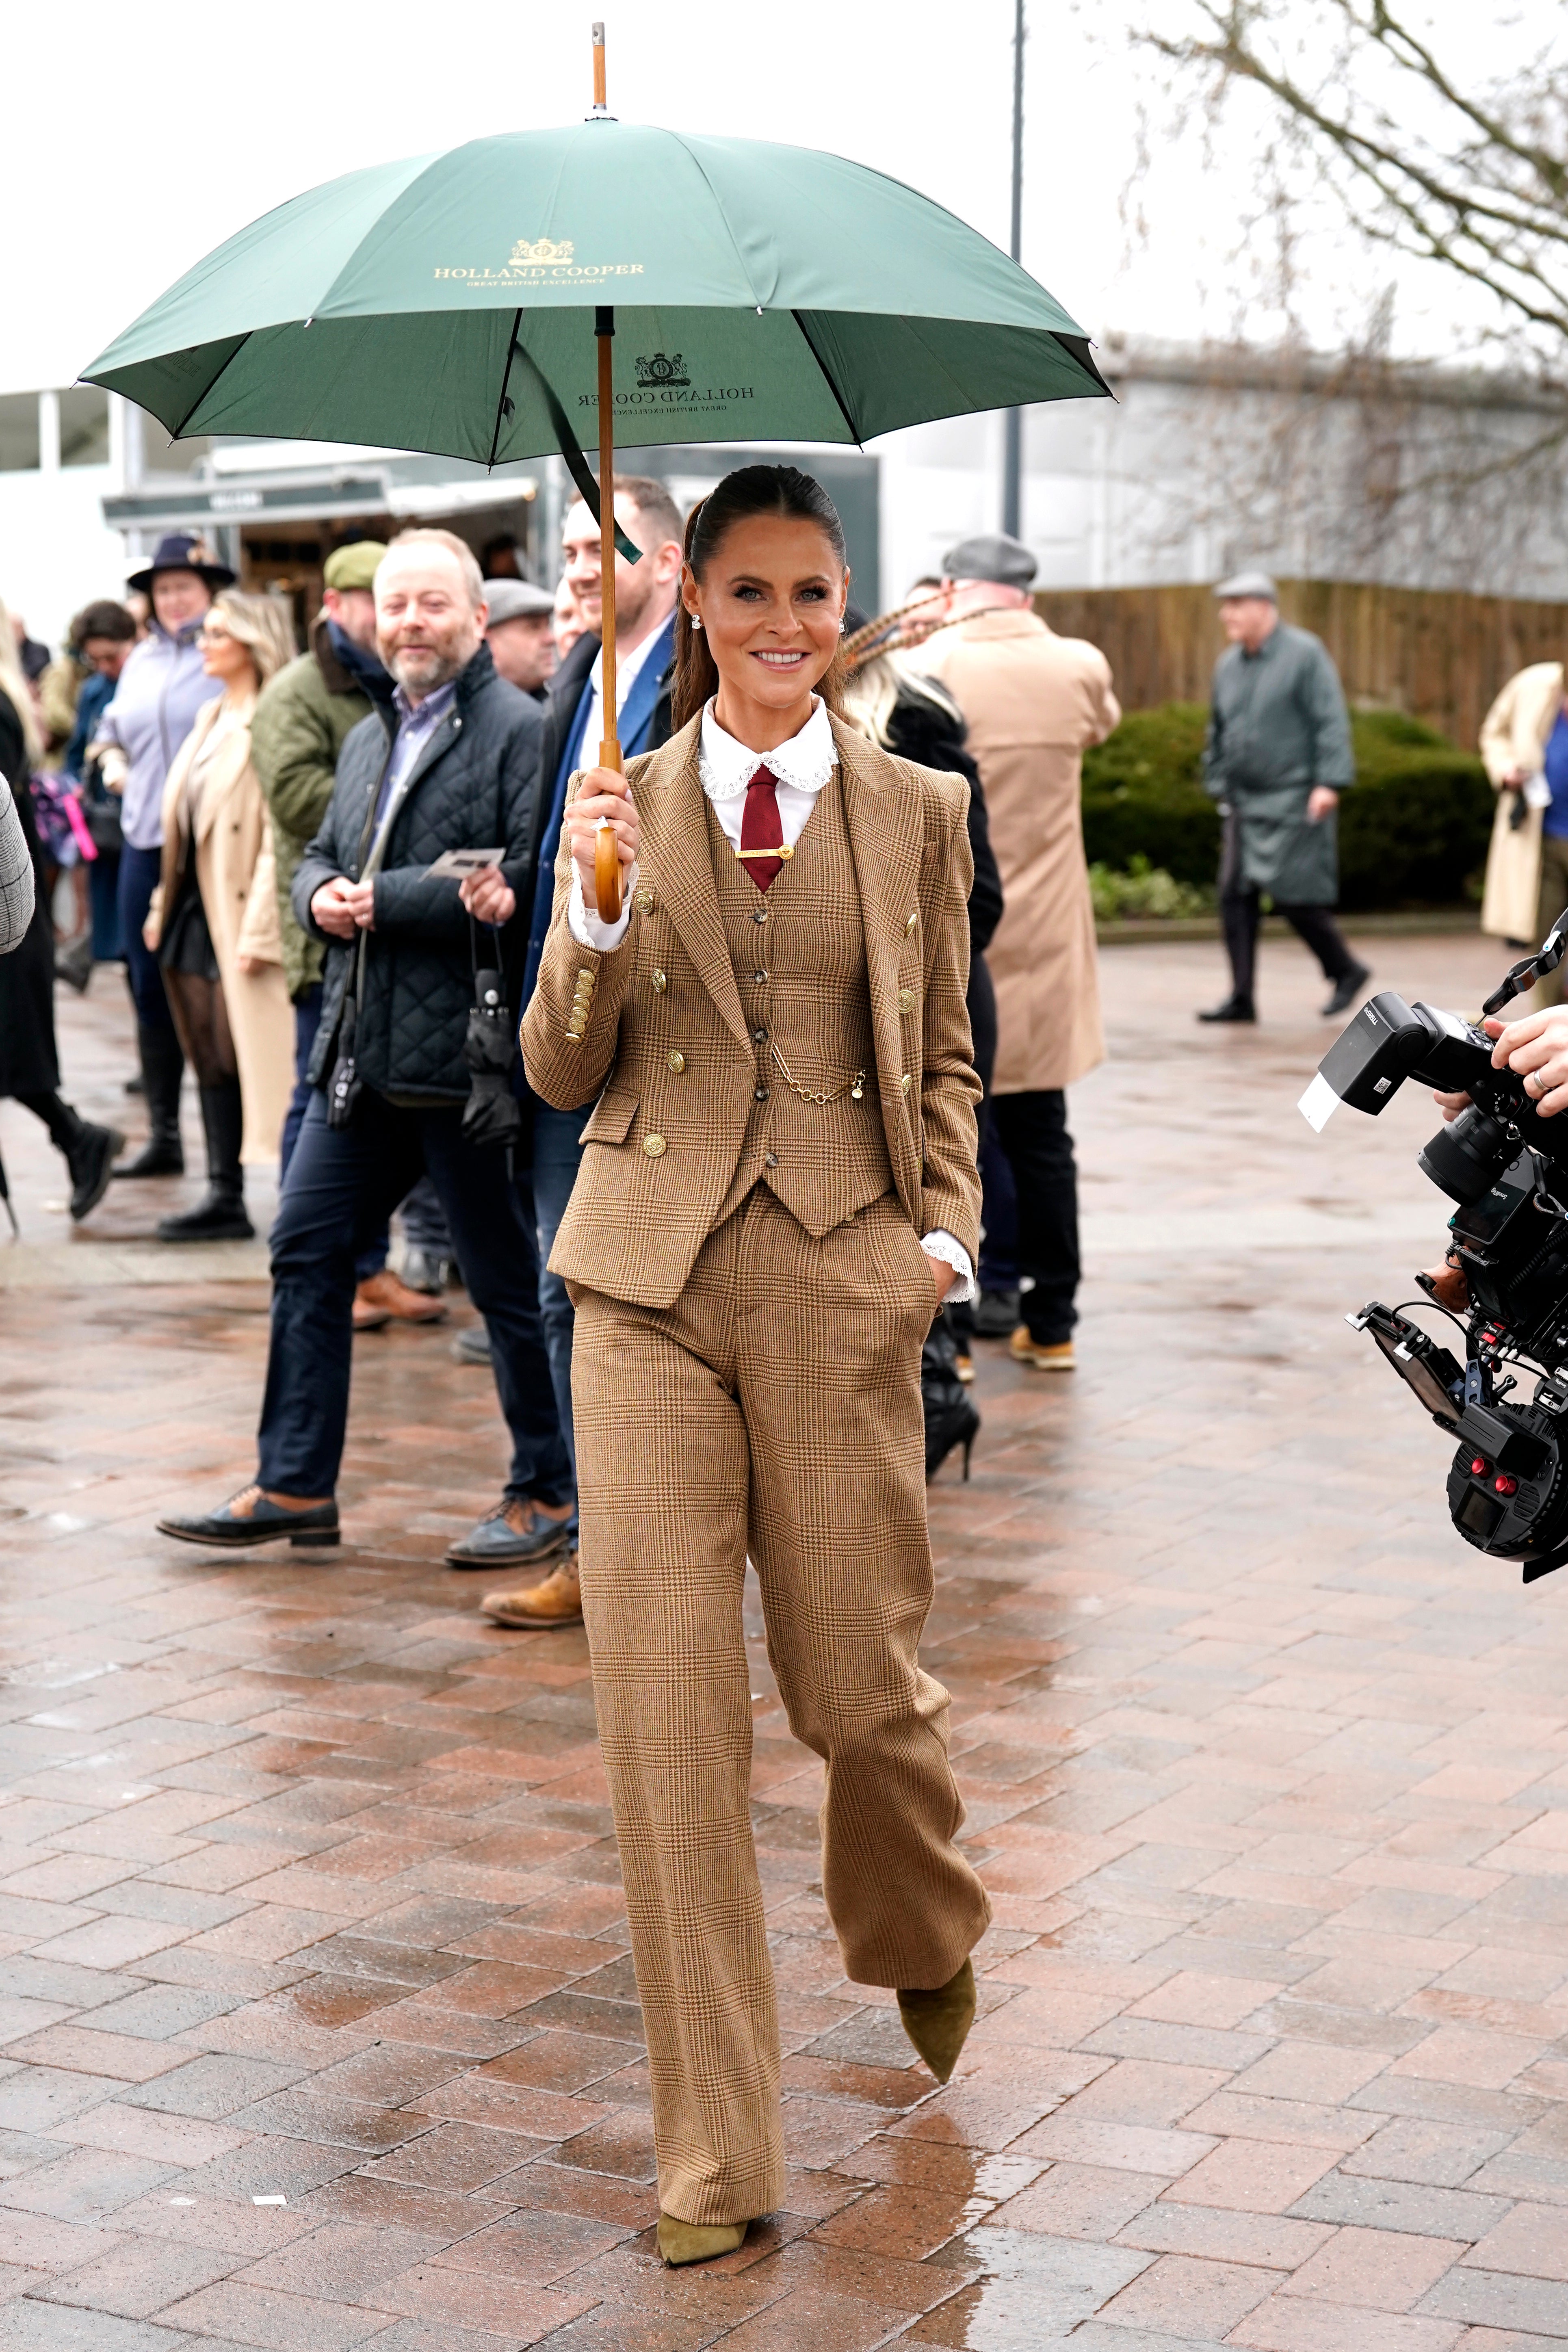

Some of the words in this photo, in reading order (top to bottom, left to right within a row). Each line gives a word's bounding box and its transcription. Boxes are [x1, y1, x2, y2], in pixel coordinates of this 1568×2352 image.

[433, 268, 546, 278] HOLLAND
[552, 264, 644, 277] COOPER
[1491, 1187, 1508, 1200] SmallRig
